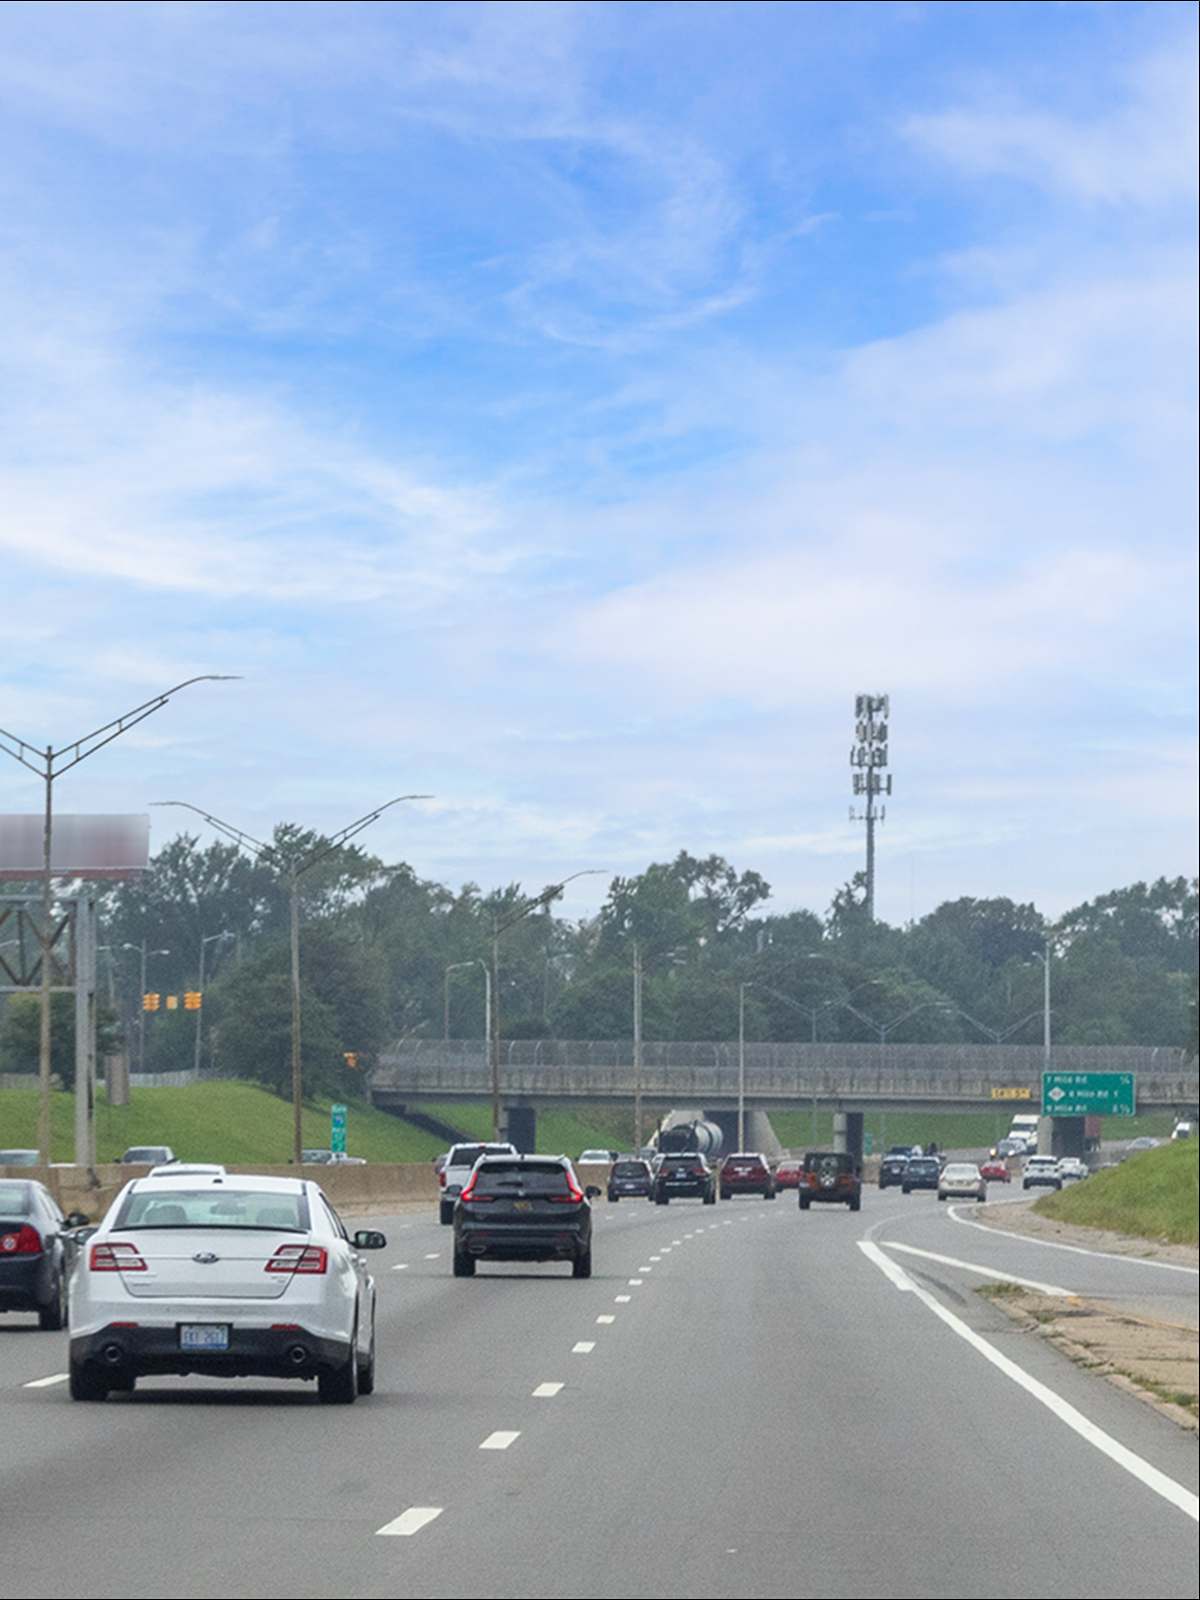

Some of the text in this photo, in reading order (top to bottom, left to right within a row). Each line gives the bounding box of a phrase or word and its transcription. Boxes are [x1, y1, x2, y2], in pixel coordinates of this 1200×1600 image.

[1046, 1076, 1051, 1084] 7
[1054, 1076, 1073, 1084] Mile
[1075, 1076, 1088, 1084] Rd
[1077, 1090, 1095, 1098] Mile
[1097, 1090, 1109, 1098] Rd
[1046, 1104, 1052, 1112] 9
[1054, 1104, 1073, 1112] Mile
[1075, 1104, 1088, 1112] Rd
